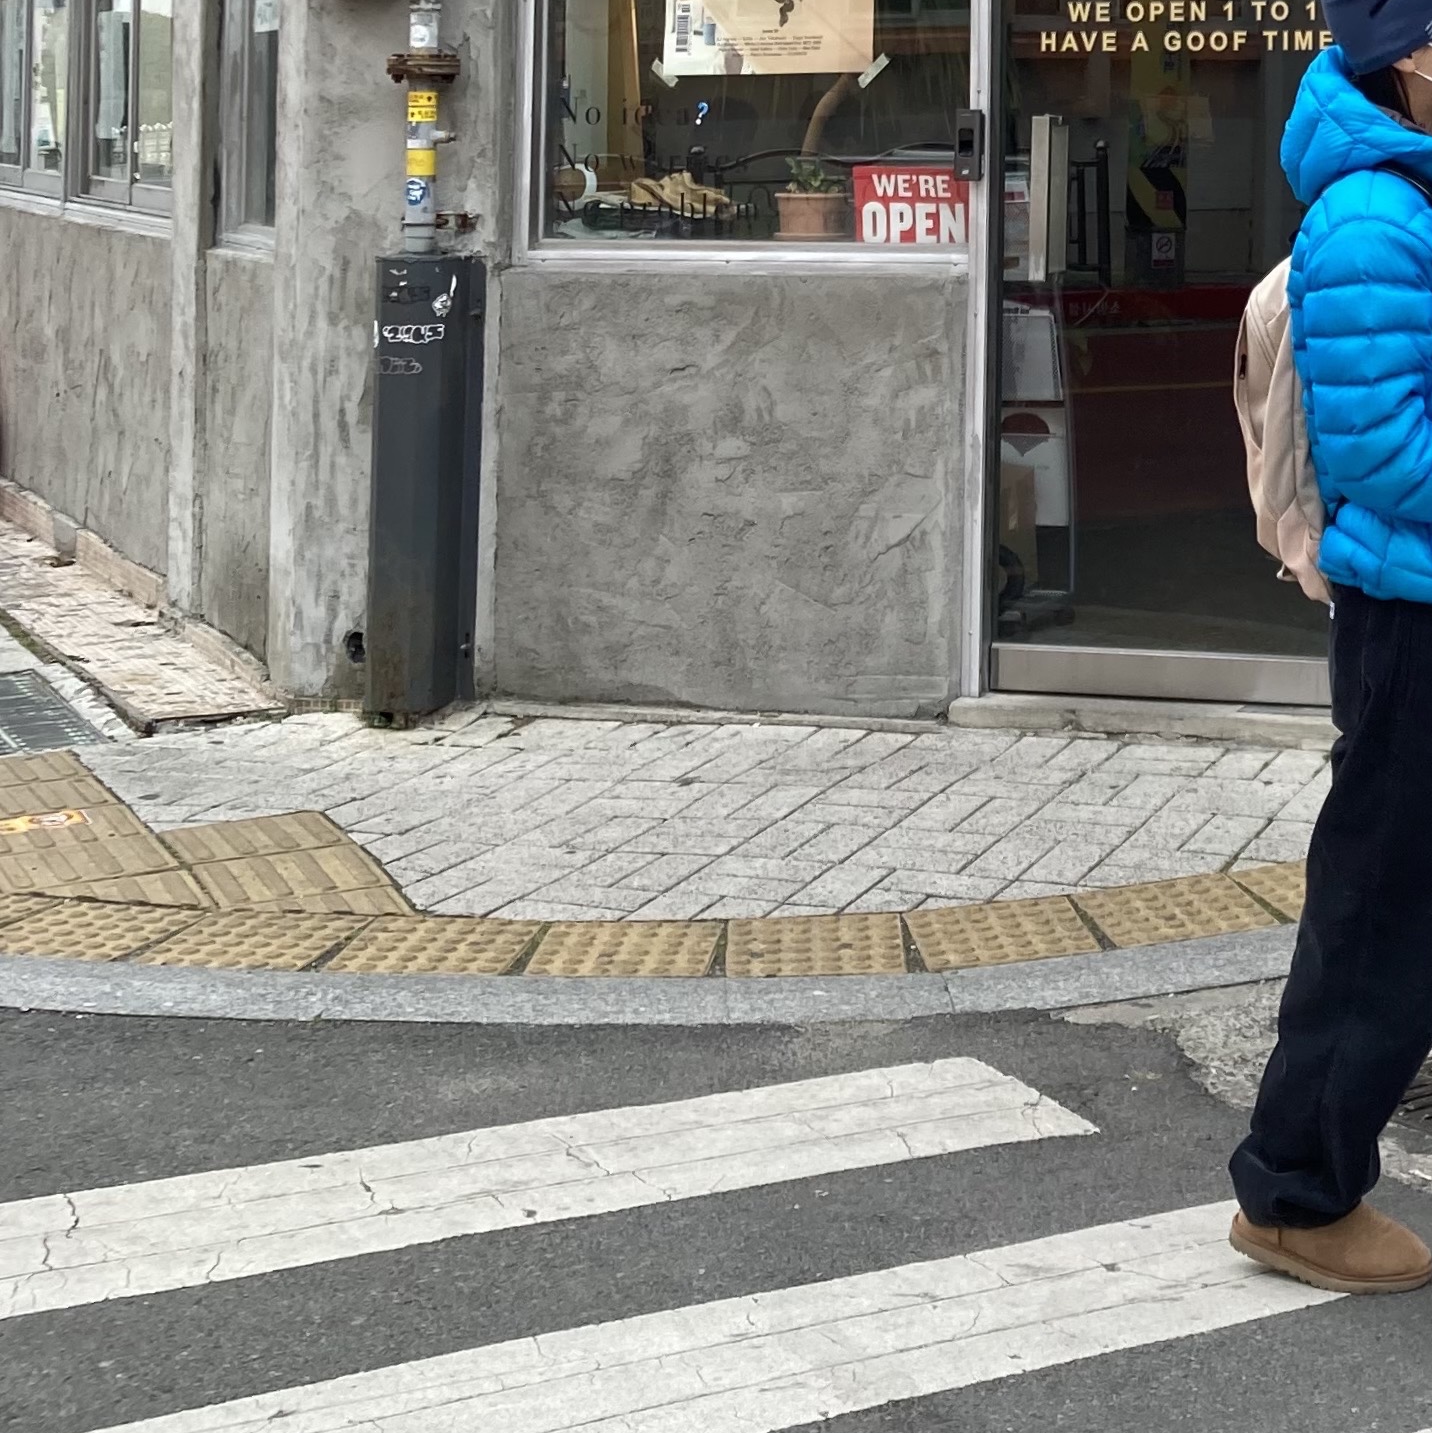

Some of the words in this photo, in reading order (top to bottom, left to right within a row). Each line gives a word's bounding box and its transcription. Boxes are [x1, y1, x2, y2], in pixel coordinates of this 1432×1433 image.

[1067, 1, 1111, 22] WE
[1126, 0, 1206, 23] OPEN
[1223, 0, 1235, 21] 1
[1251, 0, 1290, 21] TO
[1040, 31, 1117, 53] HAVE
[1131, 31, 1150, 52] A
[1164, 31, 1248, 52] GOOF
[862, 201, 966, 244] OPEN
